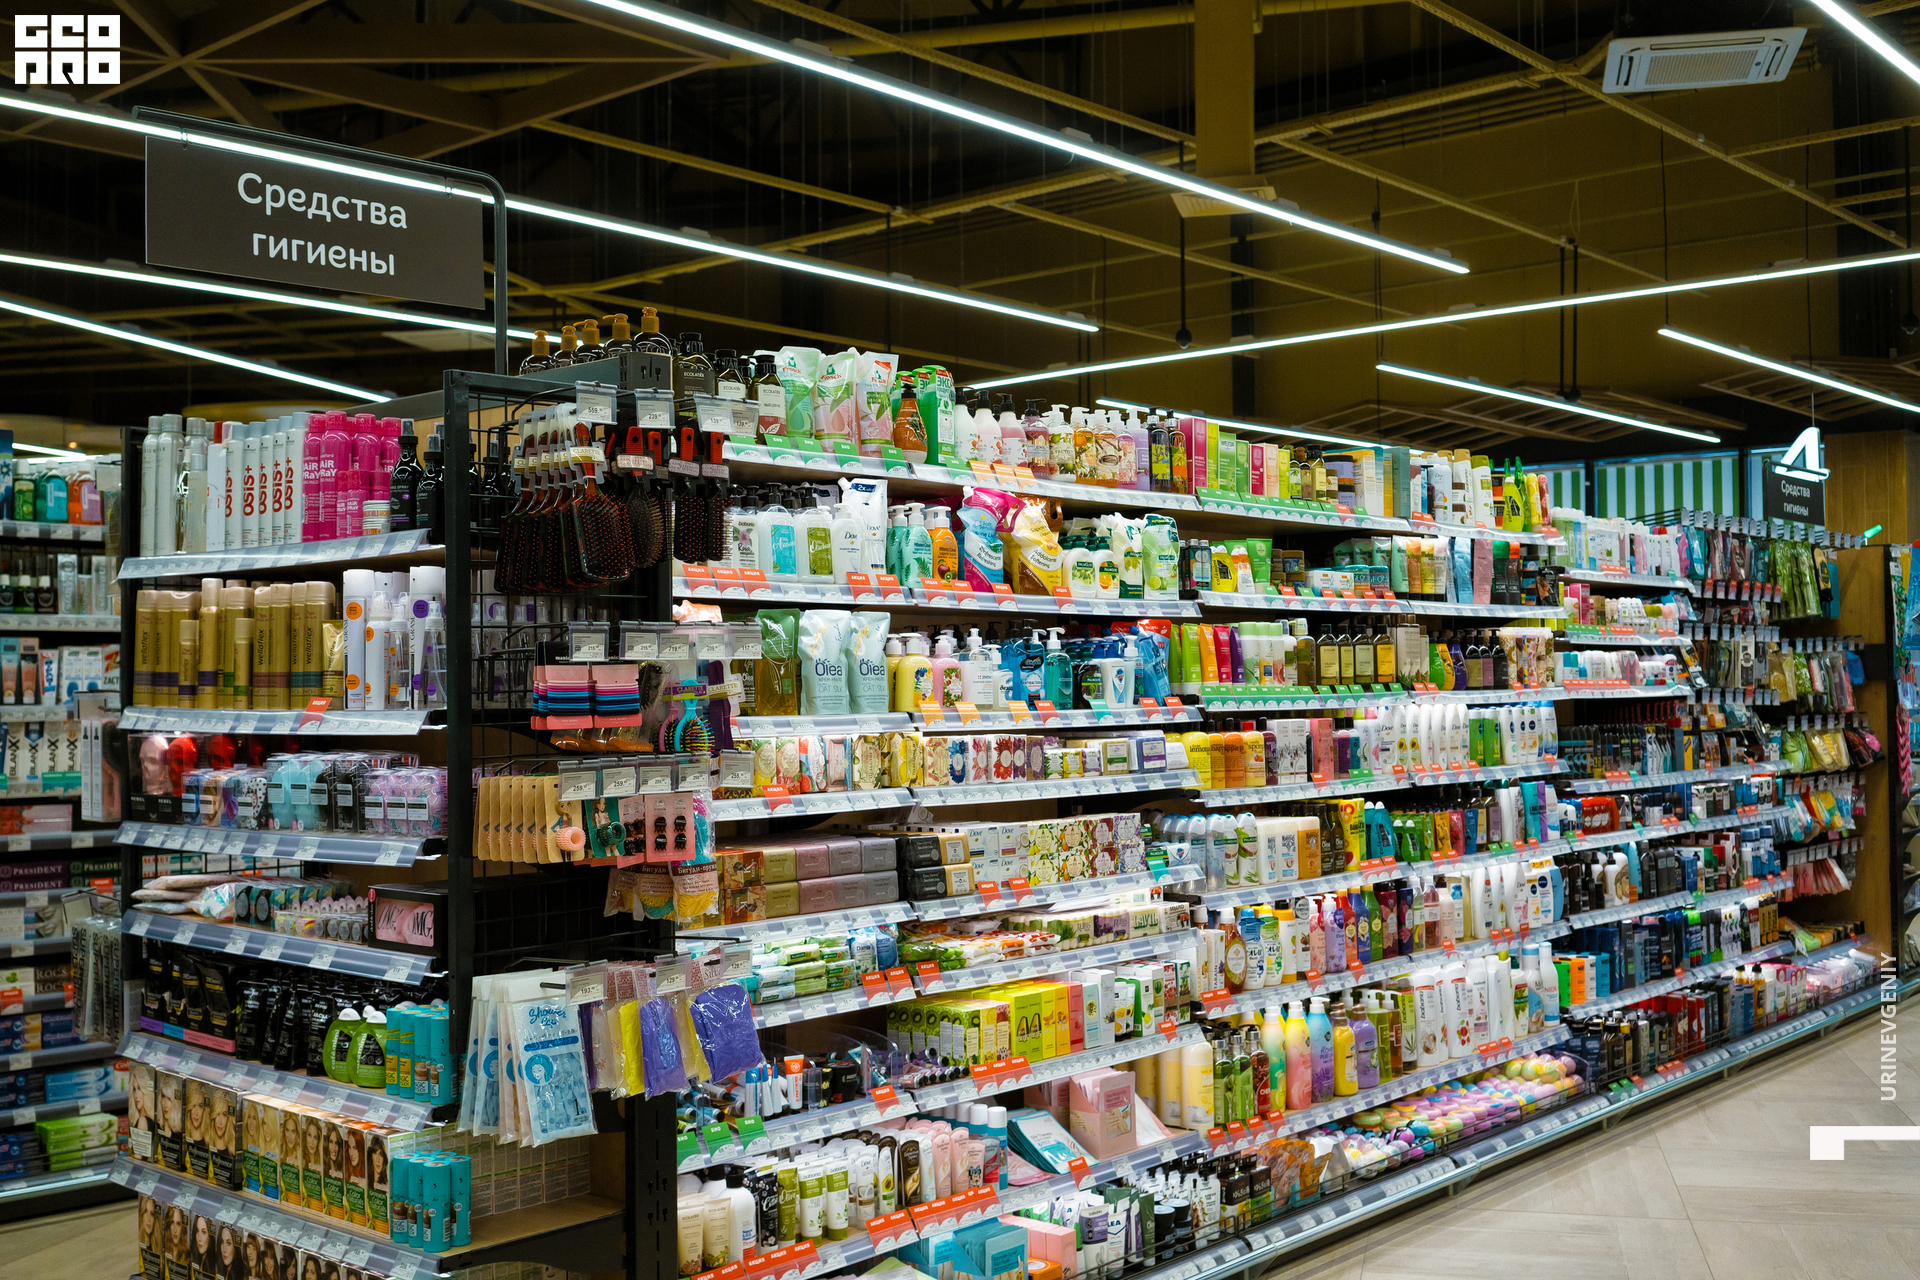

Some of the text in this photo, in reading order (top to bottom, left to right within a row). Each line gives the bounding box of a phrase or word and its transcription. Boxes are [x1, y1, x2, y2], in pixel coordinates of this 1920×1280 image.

[237, 171, 408, 231] Средства
[252, 232, 396, 277] гигиены
[573, 448, 602, 456] CLARETTE
[1781, 480, 1810, 498] Средства
[1784, 502, 1809, 517] гигиены
[845, 531, 858, 539] Dove
[103, 676, 119, 685] ZACT
[708, 683, 738, 693] CLARETTE
[1001, 826, 1015, 834] Dove
[1001, 858, 1014, 866] Dove
[529, 1006, 566, 1024] Shower
[830, 1165, 847, 1173] babaria
[870, 1218, 884, 1226] АКЦИЯ
[795, 1243, 810, 1251] АКЦИЯ
[771, 1250, 787, 1258] АКЦИЯ
[722, 1265, 738, 1274] АКЦИЯ
